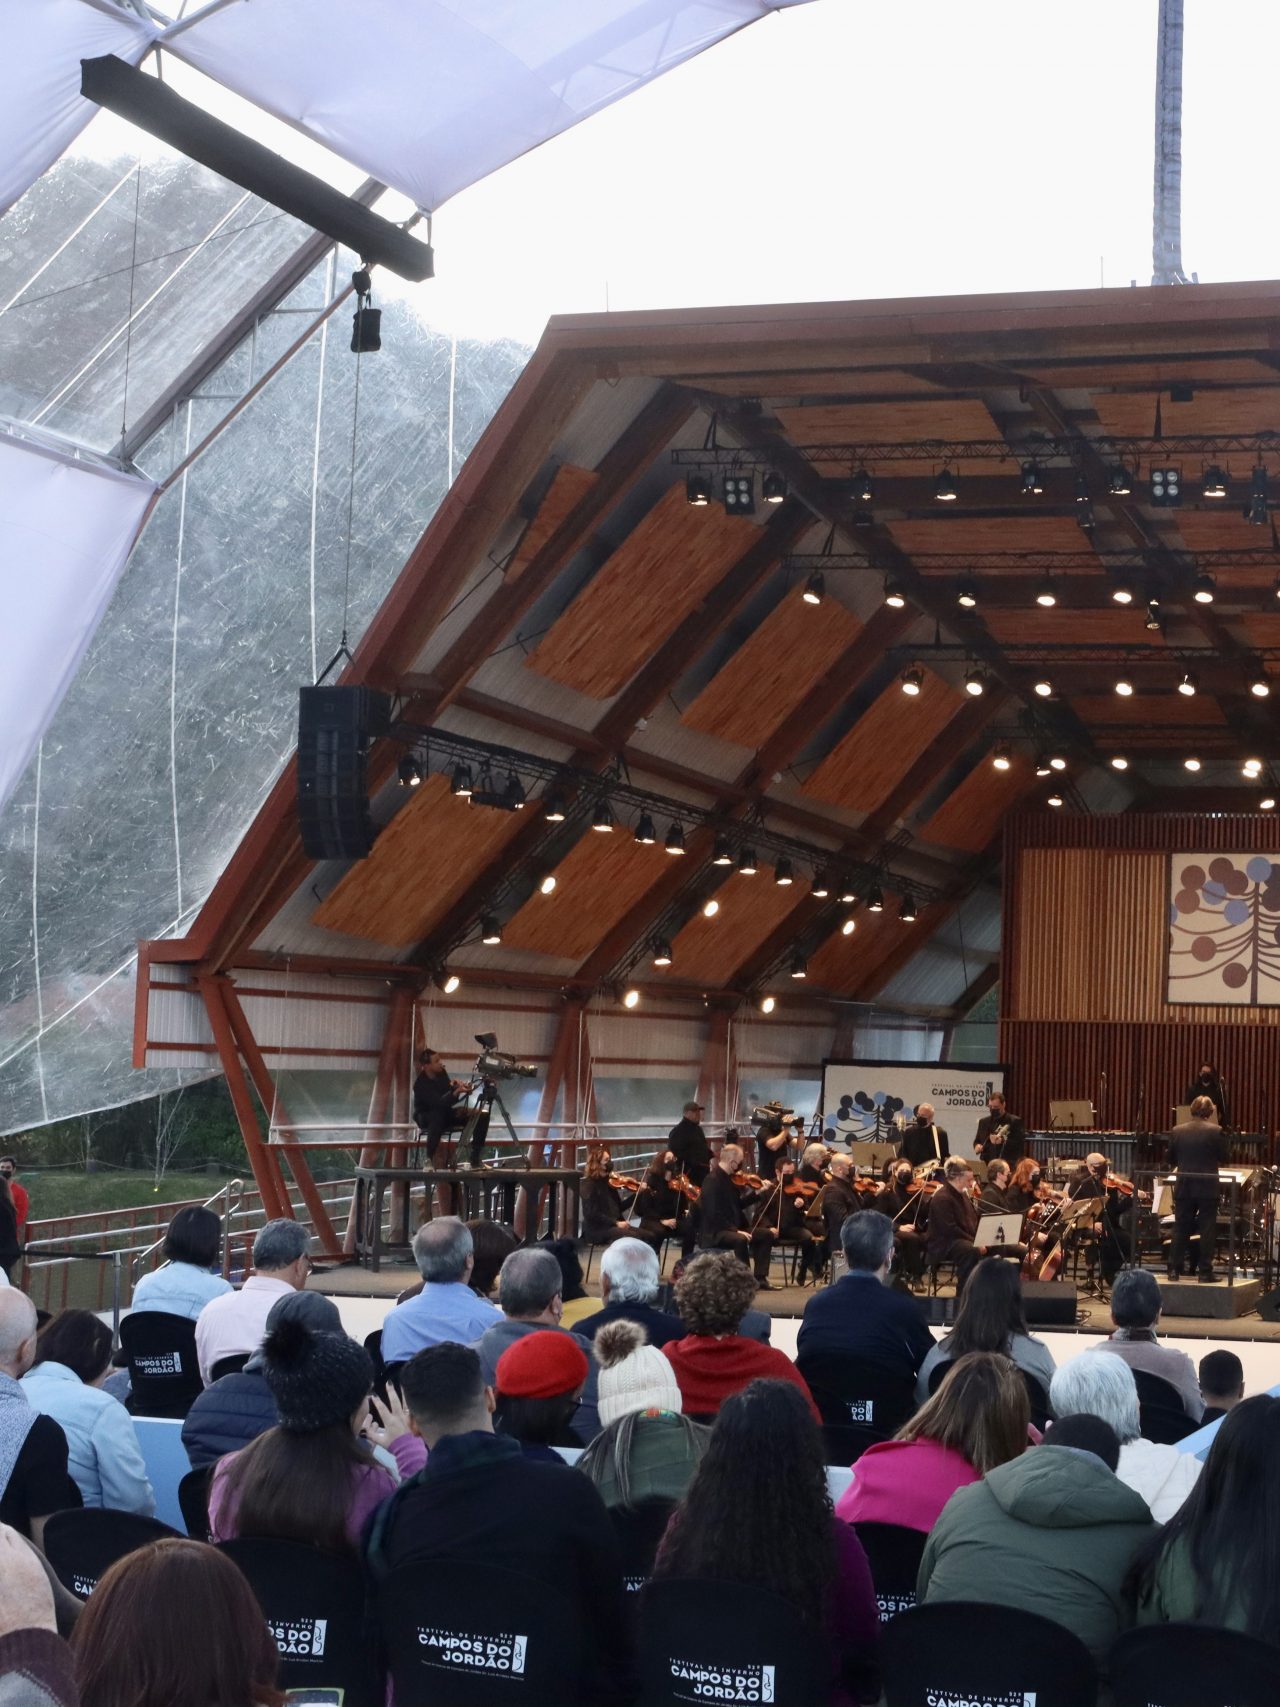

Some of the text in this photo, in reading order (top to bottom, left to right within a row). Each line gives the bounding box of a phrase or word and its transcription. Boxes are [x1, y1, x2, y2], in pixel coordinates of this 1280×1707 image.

[932, 1088, 970, 1097] CAMPOS
[946, 1097, 984, 1106] JORDÃO
[276, 1621, 312, 1629] INVERNO
[288, 1630, 311, 1641] DO
[418, 1626, 454, 1636] FESTIVAL
[473, 1634, 512, 1645] INVERNO
[278, 1641, 310, 1654] DÃO
[418, 1634, 511, 1657] CAMPOS DO
[442, 1650, 510, 1670] JORDÃO
[670, 1658, 703, 1669] FESTIVAL
[722, 1668, 760, 1676] INVERNO
[671, 1665, 760, 1688] CAMPOS DO
[694, 1684, 760, 1702] JORDÃO
[926, 1688, 963, 1699] FESTIVAL
